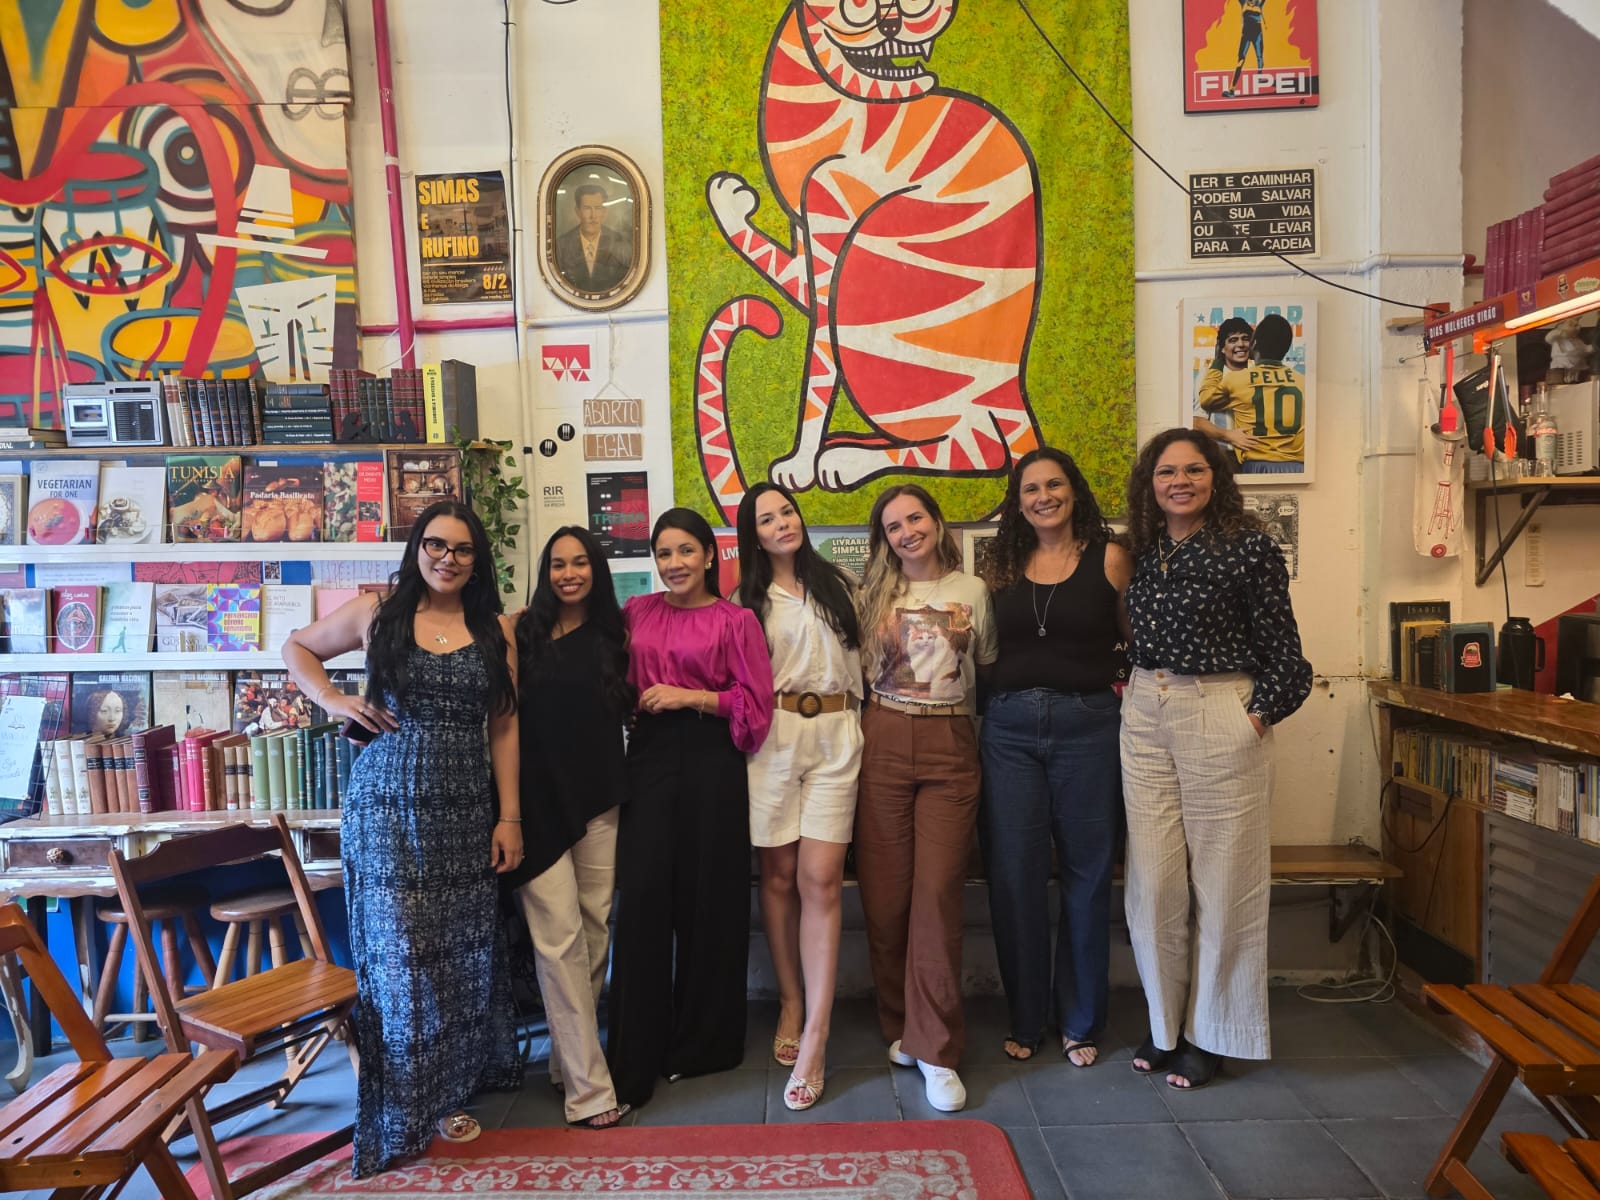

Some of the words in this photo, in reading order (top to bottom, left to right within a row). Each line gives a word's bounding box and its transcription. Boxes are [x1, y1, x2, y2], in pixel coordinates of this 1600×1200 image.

[1200, 72, 1305, 97] FLIPEI
[1193, 177, 1218, 188] LER
[1225, 176, 1235, 187] E
[1241, 172, 1311, 186] CAMINHAR
[418, 178, 480, 205] SIMAS
[1193, 192, 1241, 204] PODEM
[1262, 189, 1311, 201] SALVAR
[1193, 210, 1203, 221] A
[1229, 207, 1256, 219] SUA
[1281, 205, 1311, 216] VIDA
[421, 213, 429, 230] E
[1194, 225, 1214, 237] OU
[1233, 224, 1250, 235] TE
[1270, 221, 1311, 234] LEVAR
[422, 236, 479, 258] RUFINO
[1194, 241, 1229, 253] PARA
[1241, 240, 1251, 251] A
[1263, 237, 1311, 250] CADEIA
[482, 273, 507, 290] 8/2
[1429, 324, 1443, 339] DIAS
[1444, 312, 1475, 334] MULHERES
[1477, 305, 1496, 324] VIRÃO
[584, 400, 640, 425] ABORTO
[1251, 385, 1303, 437] 10
[584, 434, 641, 458] LEGAL
[169, 465, 235, 479] TUNISIA
[37, 479, 92, 489] VEGETARIAN
[543, 486, 564, 496] RIR
[250, 491, 278, 499] Padaria
[280, 491, 315, 499] Basilicata
[832, 538, 870, 546] LIVRARIA
[832, 546, 871, 554] SIMPLES
